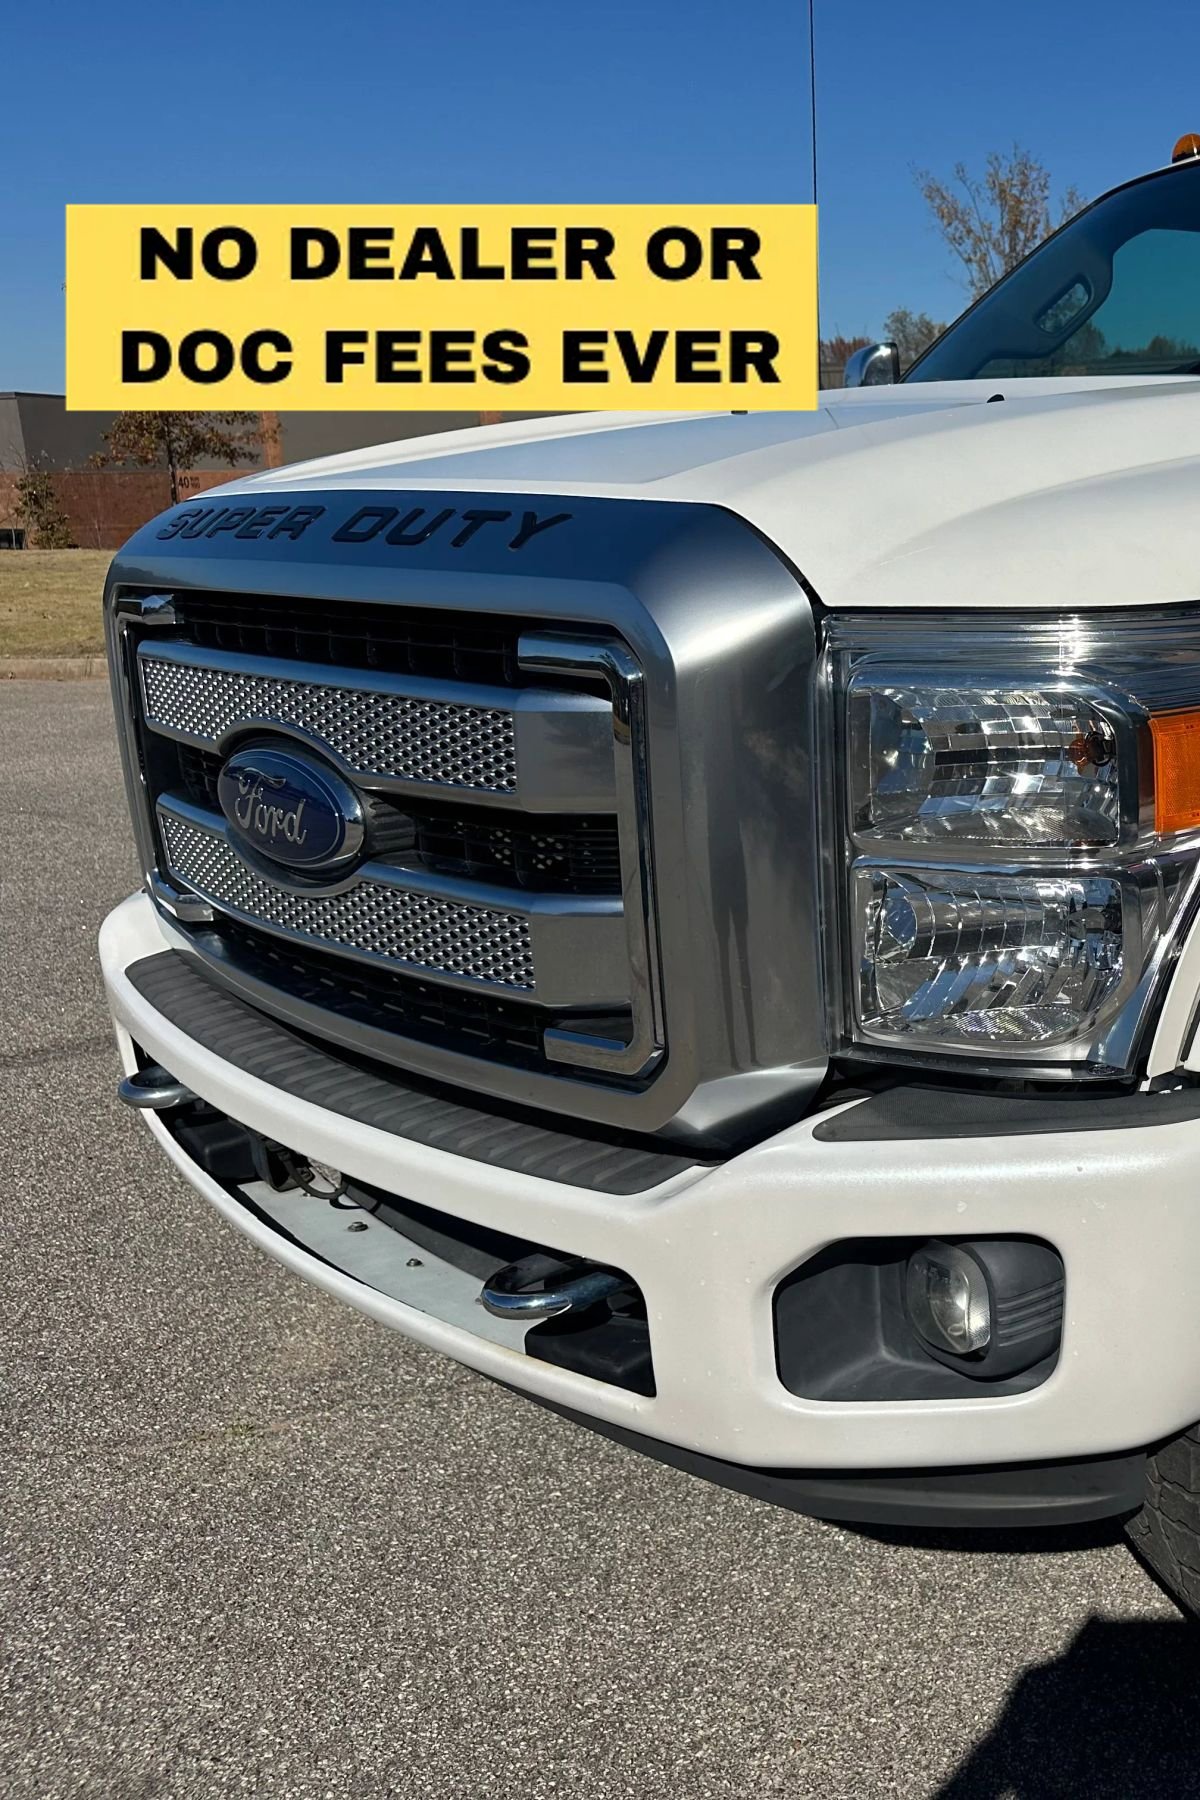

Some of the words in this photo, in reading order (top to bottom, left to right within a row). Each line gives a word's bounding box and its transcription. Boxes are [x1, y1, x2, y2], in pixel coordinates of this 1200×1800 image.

[156, 505, 326, 541] SUPER
[331, 506, 574, 552] DUTY
[234, 767, 307, 845] Ford
